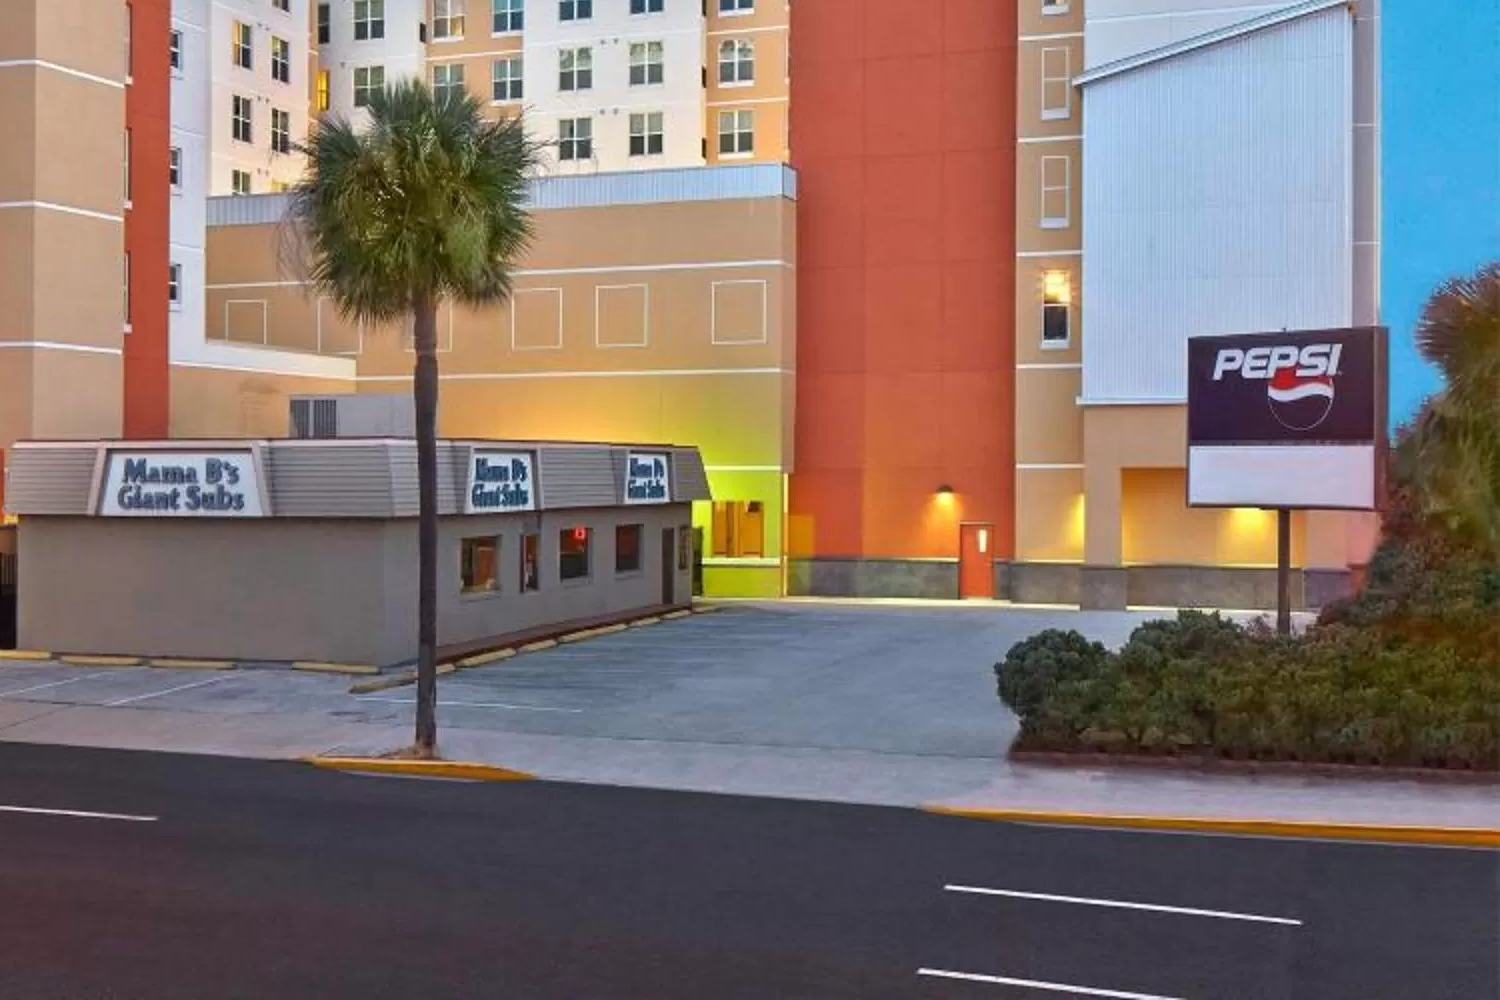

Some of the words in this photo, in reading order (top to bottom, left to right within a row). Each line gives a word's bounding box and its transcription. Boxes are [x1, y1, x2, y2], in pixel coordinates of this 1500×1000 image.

[1212, 343, 1343, 381] PEPSI
[122, 457, 199, 485] Mama
[205, 457, 241, 485] B's
[117, 484, 181, 511] Giant
[184, 484, 246, 511] Subs
